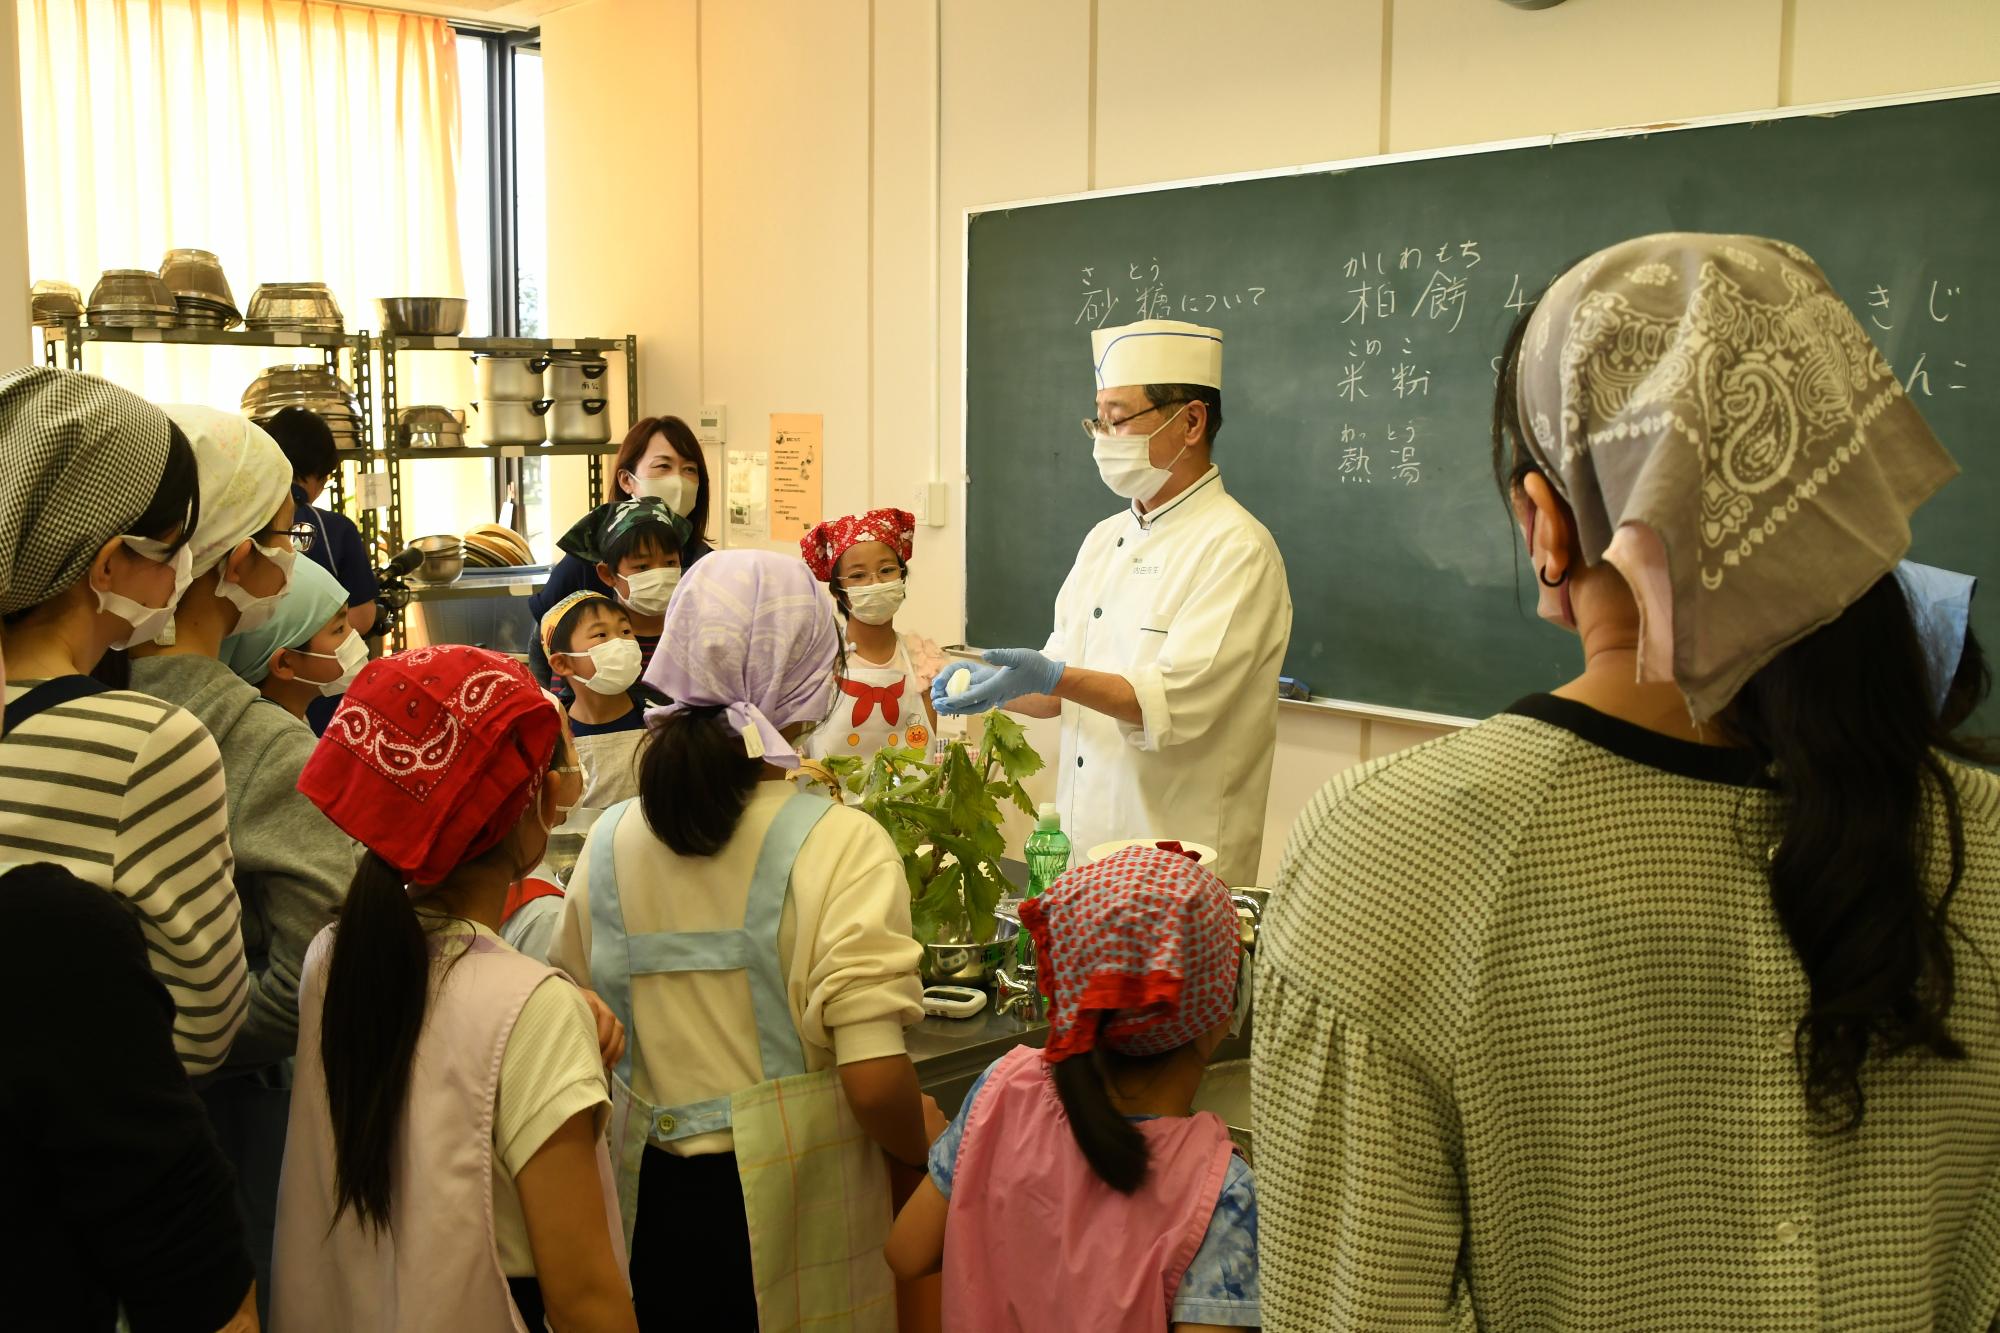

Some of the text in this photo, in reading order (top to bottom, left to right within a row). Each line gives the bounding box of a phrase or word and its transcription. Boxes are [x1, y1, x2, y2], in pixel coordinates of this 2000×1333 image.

[1343, 239, 1481, 278] かしわもち
[1340, 269, 1468, 334] 柏餅
[1867, 279, 1961, 330] きじ
[1337, 360, 1432, 402] 米粉
[1337, 446, 1422, 486] 熱湯
